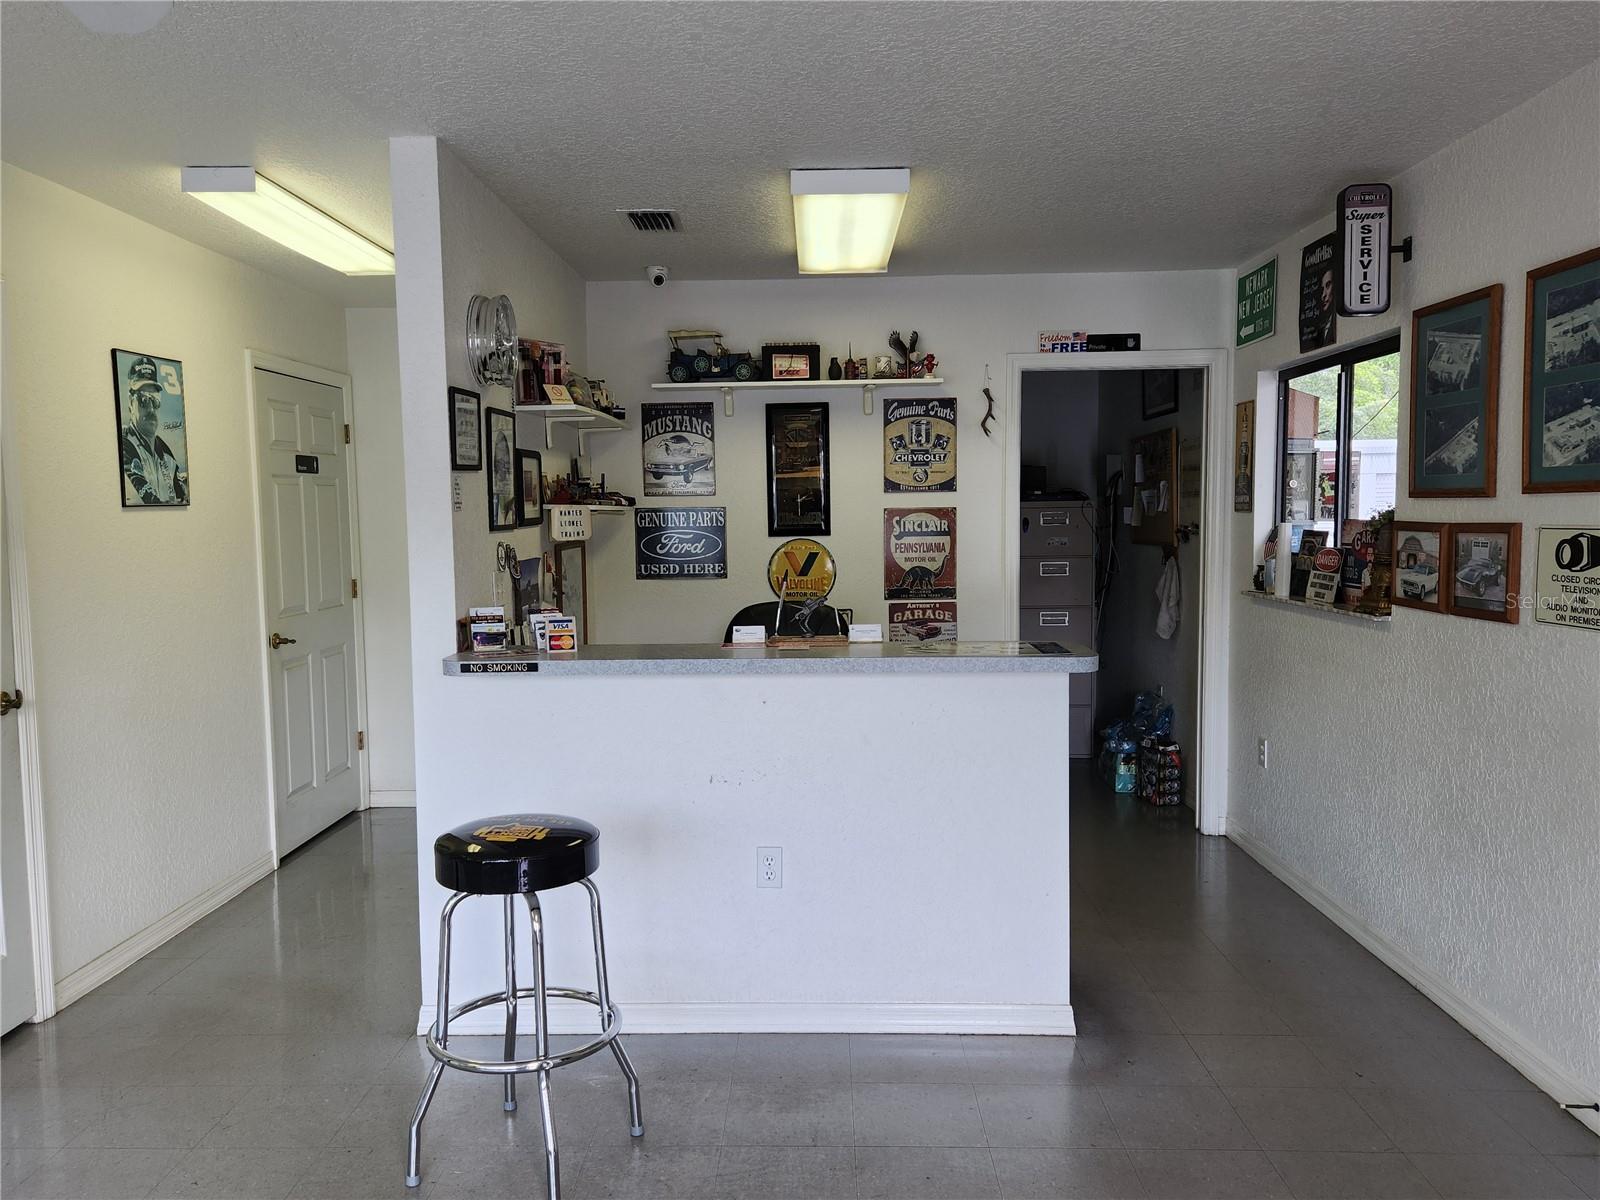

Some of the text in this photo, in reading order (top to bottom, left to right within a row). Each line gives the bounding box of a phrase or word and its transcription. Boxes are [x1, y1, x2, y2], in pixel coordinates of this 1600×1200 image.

[1345, 208, 1386, 223] Super
[1359, 224, 1373, 305] SERVICE
[1245, 268, 1269, 297] NEWARK
[1239, 286, 1274, 321] NEW JERSEY
[1040, 332, 1072, 343] Freedom
[1051, 342, 1088, 353] FREE
[159, 364, 181, 395] 3
[888, 401, 954, 421] Genuine Parts
[644, 415, 712, 440] MUSTANG
[895, 453, 945, 462] CHEVROLET
[559, 509, 583, 517] WANTED
[637, 511, 725, 527] GENUINE PARTS
[892, 516, 949, 535] SINCLAIR
[656, 533, 706, 554] Ford
[895, 542, 946, 554] PENNSYLVANIA
[1316, 553, 1339, 567] DANGER
[640, 563, 724, 575] USED HERE
[1551, 574, 1581, 584] CLOSED
[1574, 596, 1589, 605] AND
[1546, 603, 1568, 612] AUDIO
[894, 609, 953, 622] GARAGE
[1556, 614, 1567, 622] ON
[470, 663, 528, 672] NO SMOKING
